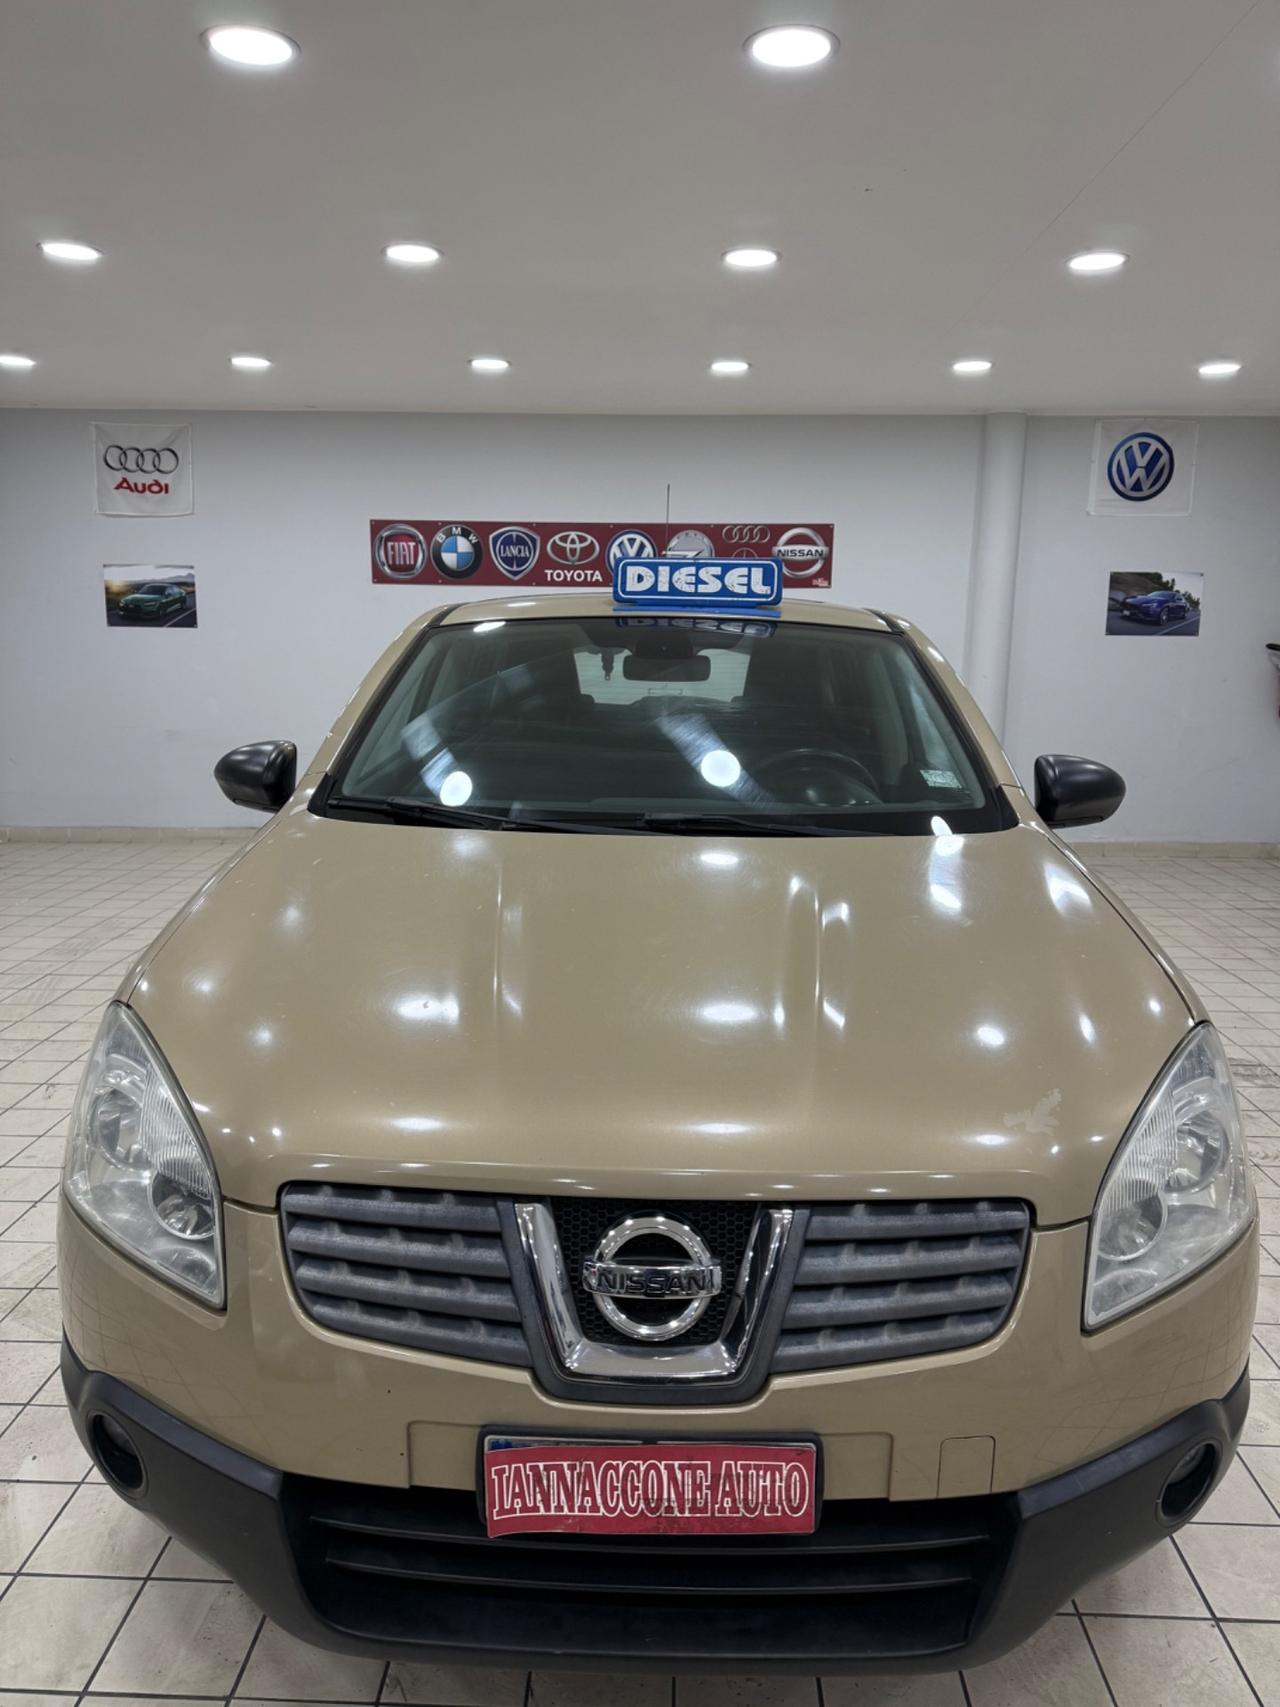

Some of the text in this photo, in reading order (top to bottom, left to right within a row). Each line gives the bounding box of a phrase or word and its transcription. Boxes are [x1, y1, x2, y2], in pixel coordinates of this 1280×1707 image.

[1113, 436, 1170, 496] VW
[114, 477, 169, 494] Audi
[437, 526, 479, 545] BMW
[386, 541, 416, 565] FIAT
[500, 545, 530, 557] LANCIA
[777, 549, 824, 557] NISSAN
[544, 569, 603, 581] TOYOTA
[625, 565, 771, 595] DIESEL
[599, 1271, 706, 1294] NISSAN
[492, 1460, 809, 1519] IANNACCONE AUTO
